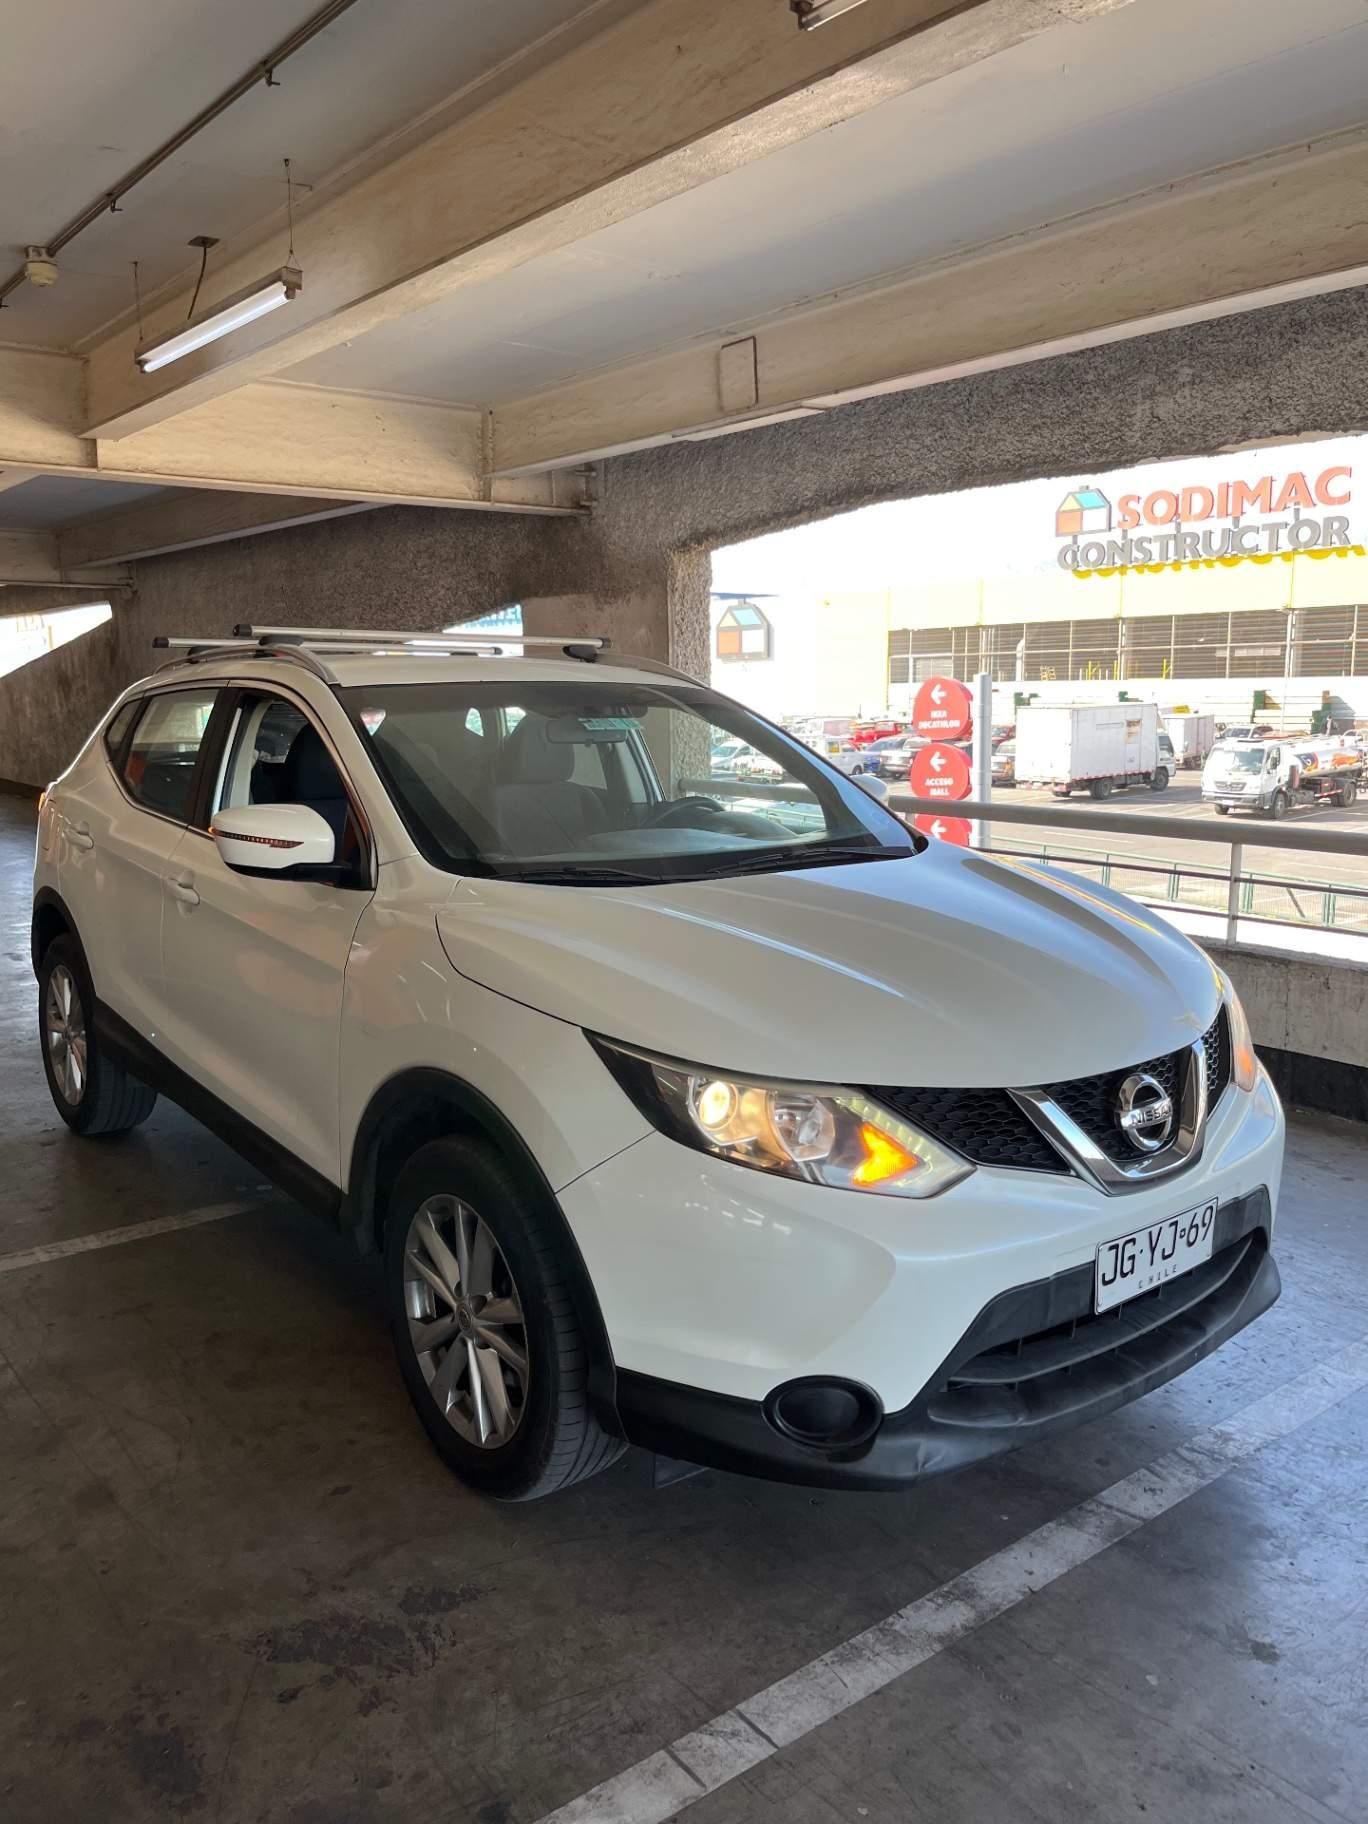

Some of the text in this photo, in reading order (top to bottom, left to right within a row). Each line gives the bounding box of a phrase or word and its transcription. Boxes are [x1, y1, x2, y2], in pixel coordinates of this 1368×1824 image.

[1117, 466, 1352, 530] SODIMAC
[1057, 515, 1351, 571] CONSTRUCTOR
[925, 777, 954, 786] ACCESO
[1138, 1264, 1177, 1289] CHILE
